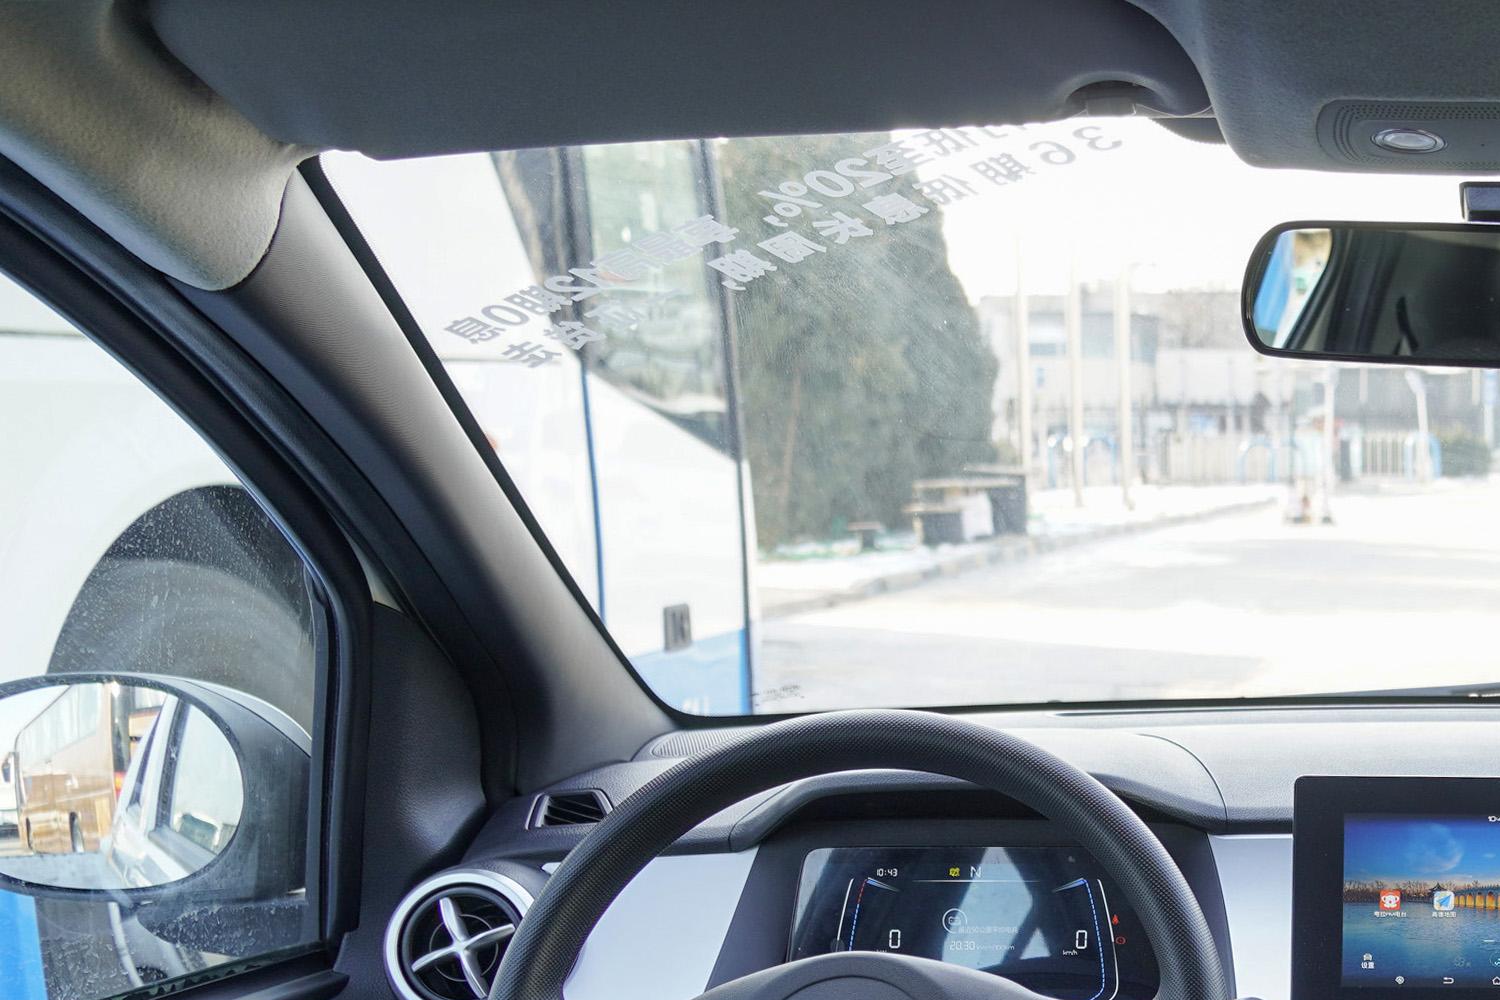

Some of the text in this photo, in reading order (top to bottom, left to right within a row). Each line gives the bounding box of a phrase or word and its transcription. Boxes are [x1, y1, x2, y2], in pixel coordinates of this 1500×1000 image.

[876, 868, 898, 877] 10:43
[970, 866, 982, 878] N
[888, 928, 902, 949] 0
[1075, 929, 1088, 950] 0
[1361, 961, 1375, 969] 设置
